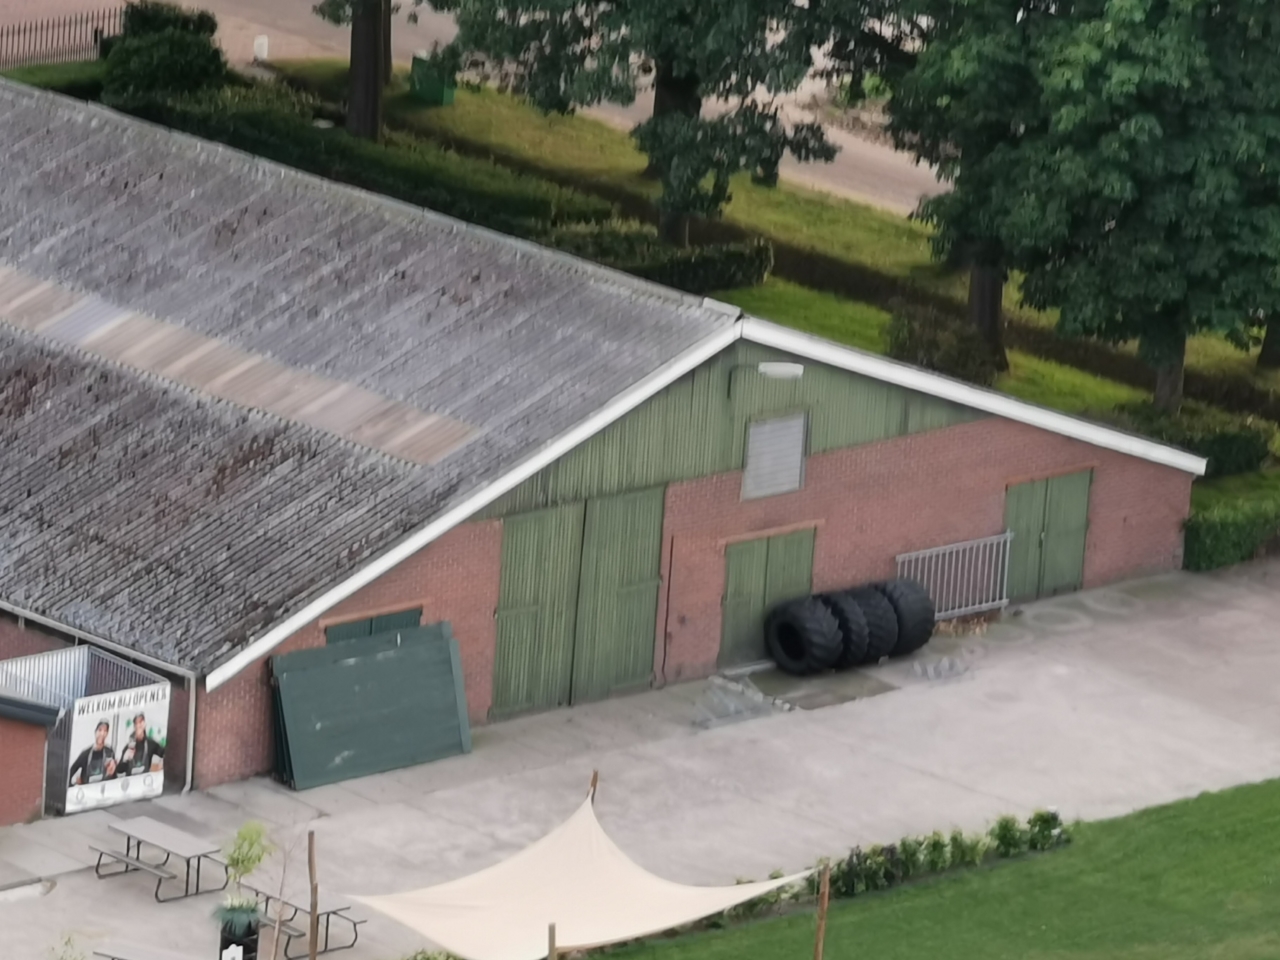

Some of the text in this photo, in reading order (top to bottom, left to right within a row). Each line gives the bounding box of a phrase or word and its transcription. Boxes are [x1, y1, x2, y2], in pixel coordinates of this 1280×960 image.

[78, 687, 167, 715] WELKOM BIJ OPENER
